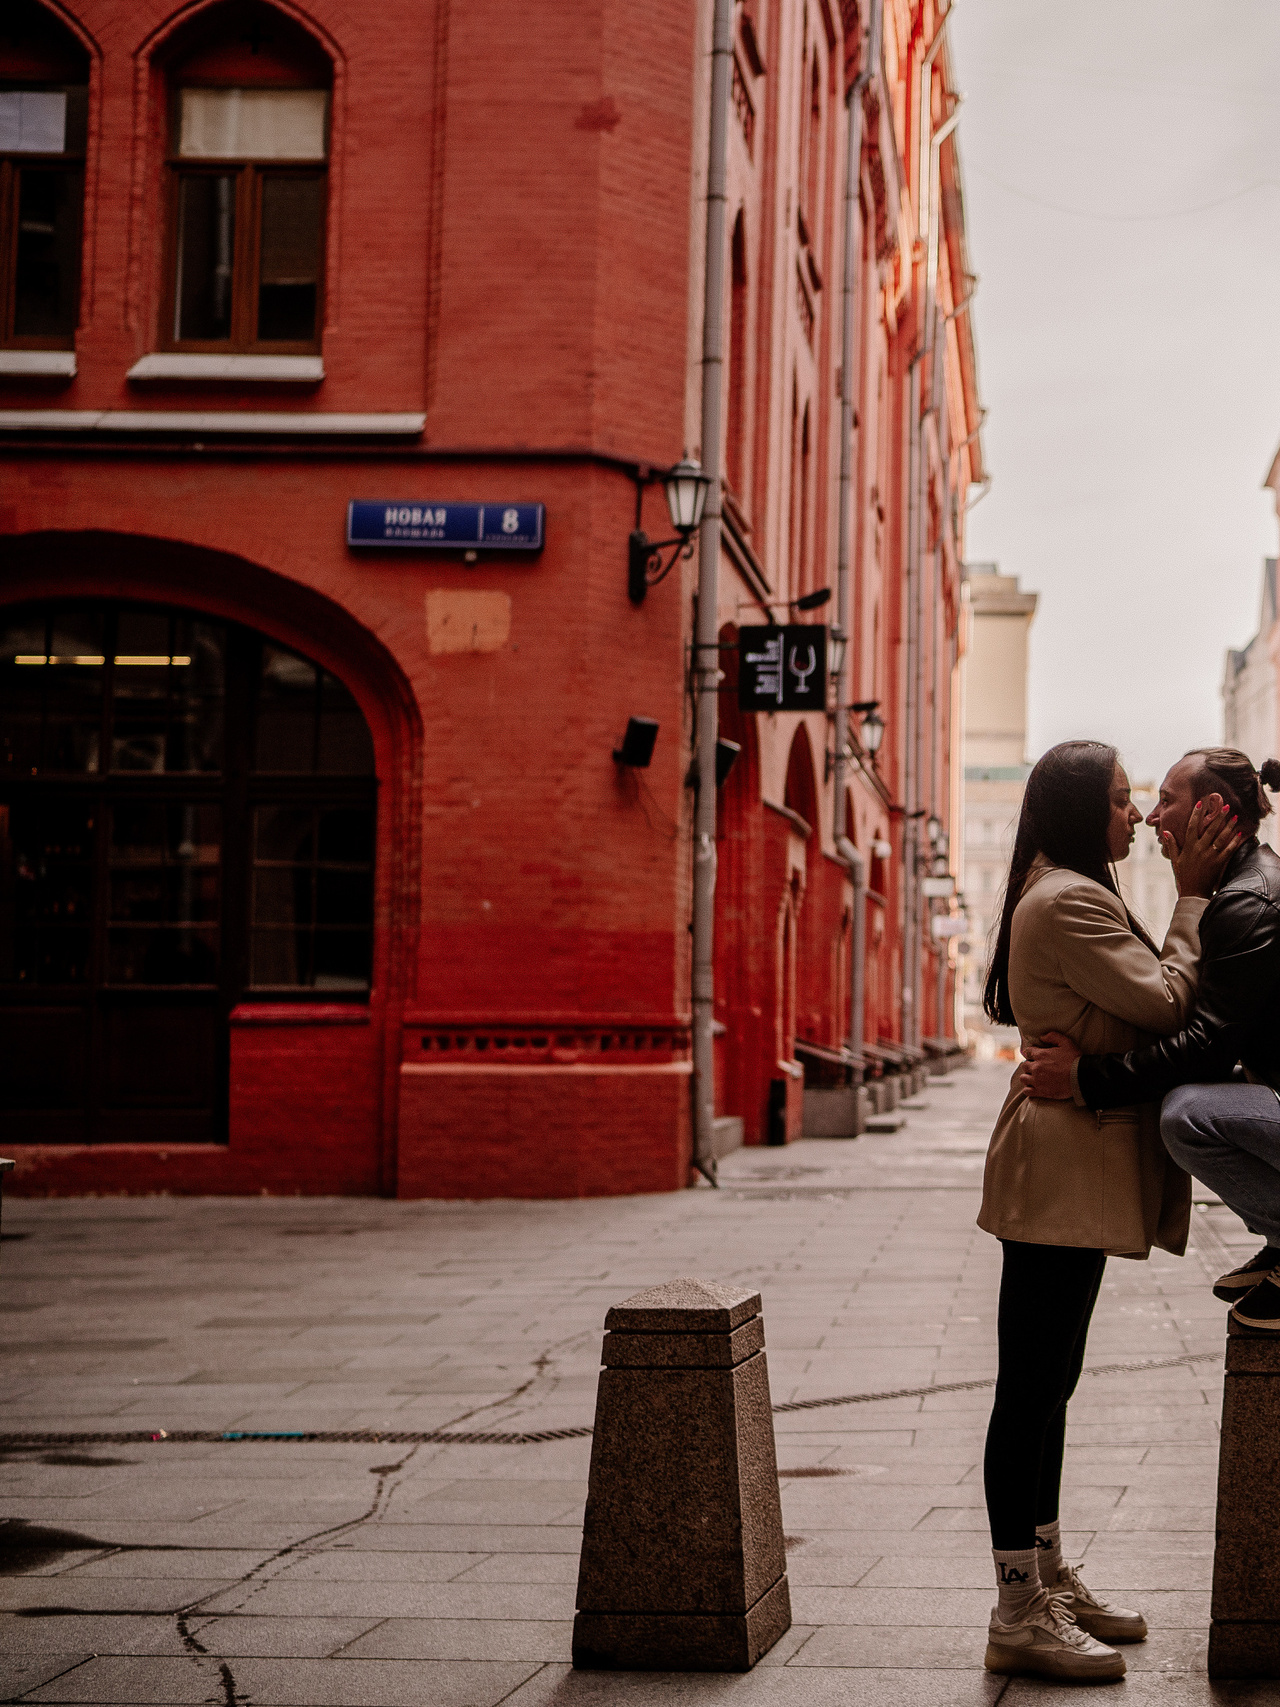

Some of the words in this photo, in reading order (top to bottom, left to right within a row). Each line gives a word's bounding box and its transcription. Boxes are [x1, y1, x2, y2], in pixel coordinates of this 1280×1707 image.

[385, 507, 447, 526] НОВАЯ
[502, 508, 519, 534] 8
[998, 1562, 1029, 1584] LA
